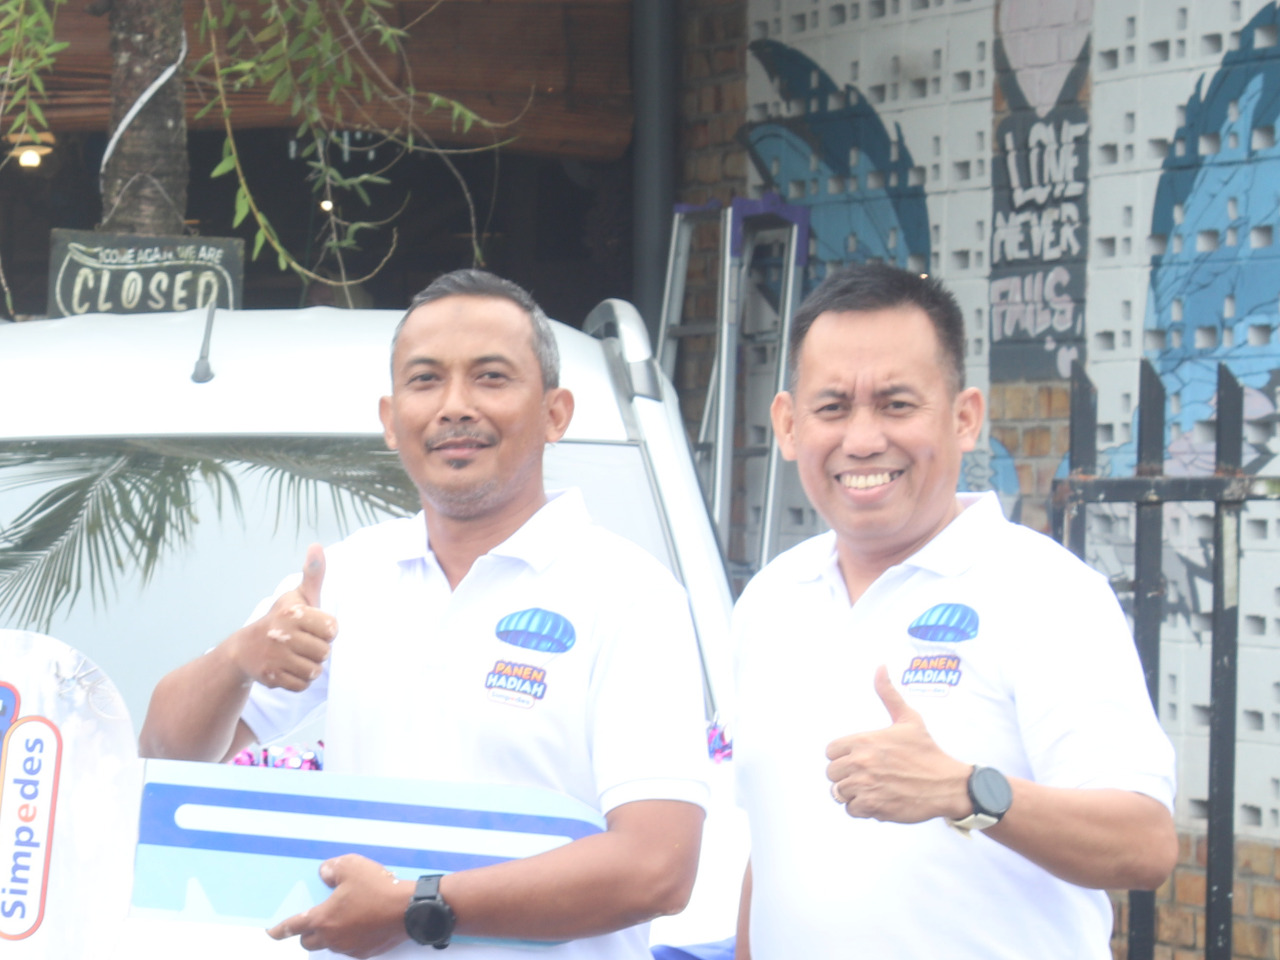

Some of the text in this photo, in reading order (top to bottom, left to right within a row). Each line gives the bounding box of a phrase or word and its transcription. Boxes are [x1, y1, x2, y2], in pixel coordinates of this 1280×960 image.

[993, 202, 1081, 264] NEVER
[71, 266, 219, 315] CLOSED
[494, 661, 545, 683] PANEN
[911, 656, 959, 670] PANEN
[486, 673, 545, 698] HADIAH
[902, 669, 961, 685] HADIAH
[0, 736, 45, 920] Simpedes
